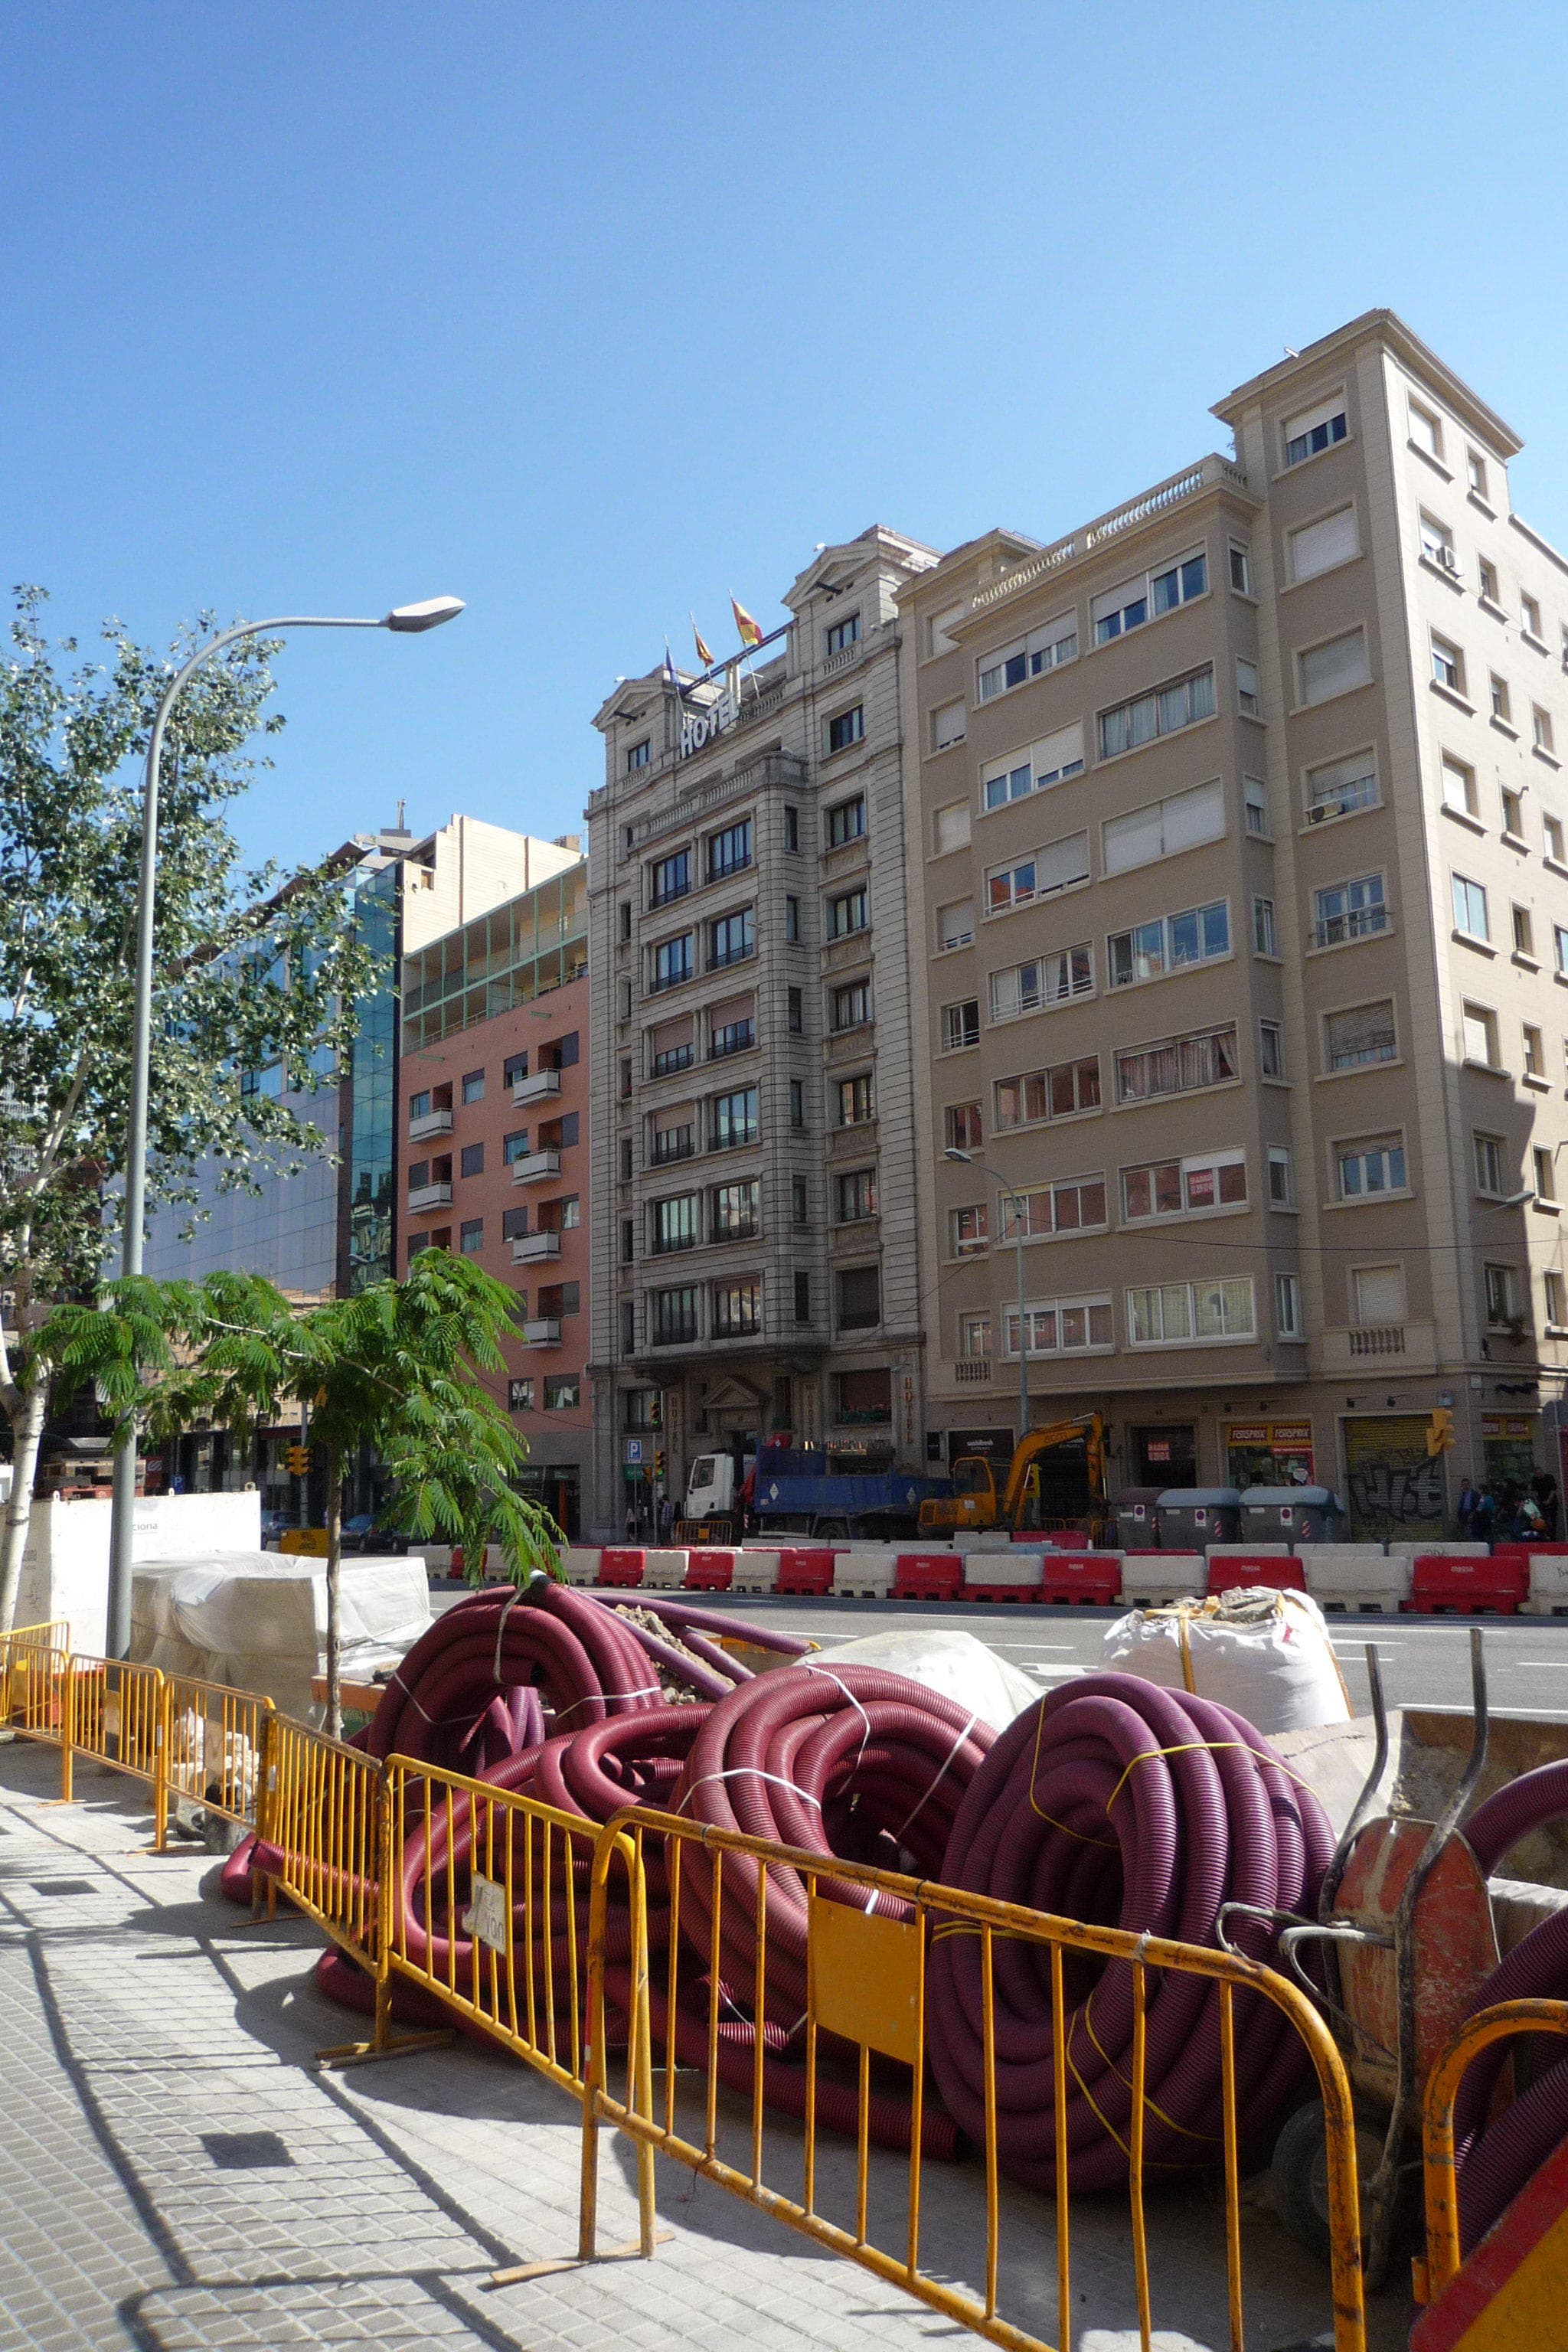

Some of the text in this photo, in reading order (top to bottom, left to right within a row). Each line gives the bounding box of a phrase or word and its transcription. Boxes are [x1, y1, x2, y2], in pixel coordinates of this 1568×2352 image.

[680, 691, 741, 759] HOTEL
[903, 1377, 913, 1443] HOTEL
[1232, 1429, 1266, 1439] FOTOPRIX
[1275, 1428, 1309, 1439] FOTOPRIX
[630, 1442, 639, 1458] P
[175, 1476, 183, 1487] P
